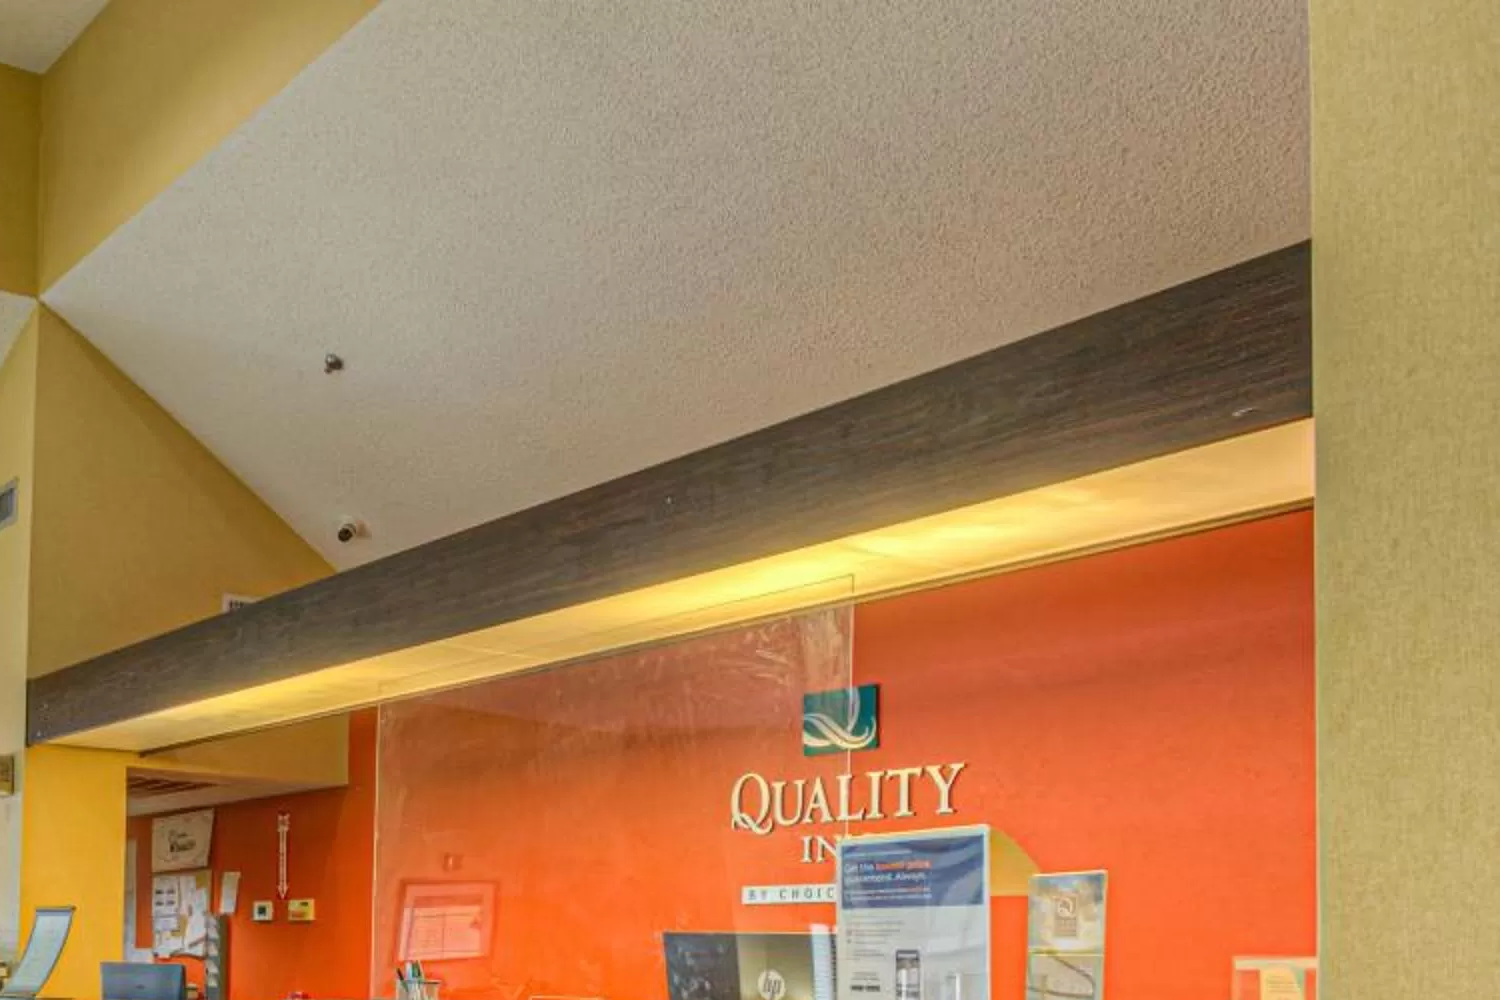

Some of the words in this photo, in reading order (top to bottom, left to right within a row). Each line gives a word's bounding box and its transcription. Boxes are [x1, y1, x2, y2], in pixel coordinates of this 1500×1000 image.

[730, 760, 968, 835] QUALITY
[800, 835, 837, 864] IN
[747, 888, 769, 901] BY
[779, 885, 836, 900] CHOIC
